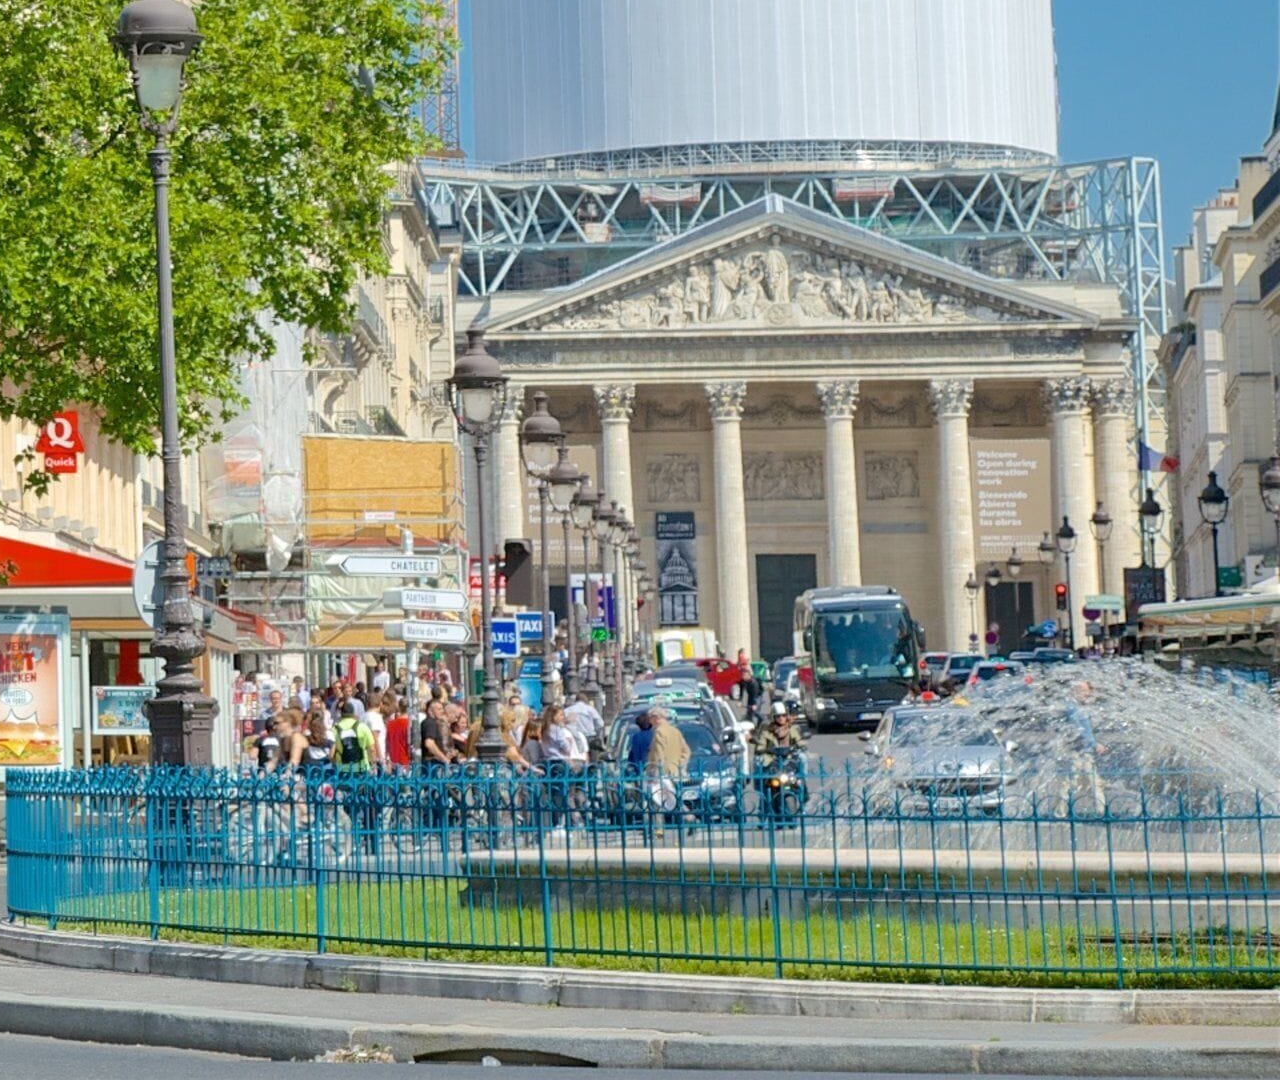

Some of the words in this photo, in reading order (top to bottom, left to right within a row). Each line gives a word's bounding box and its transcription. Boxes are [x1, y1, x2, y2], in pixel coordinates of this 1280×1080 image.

[47, 417, 75, 449] Q
[45, 457, 75, 468] Quick
[977, 460, 1004, 469] Open
[1006, 459, 1037, 469] during
[5, 641, 31, 652] VERY
